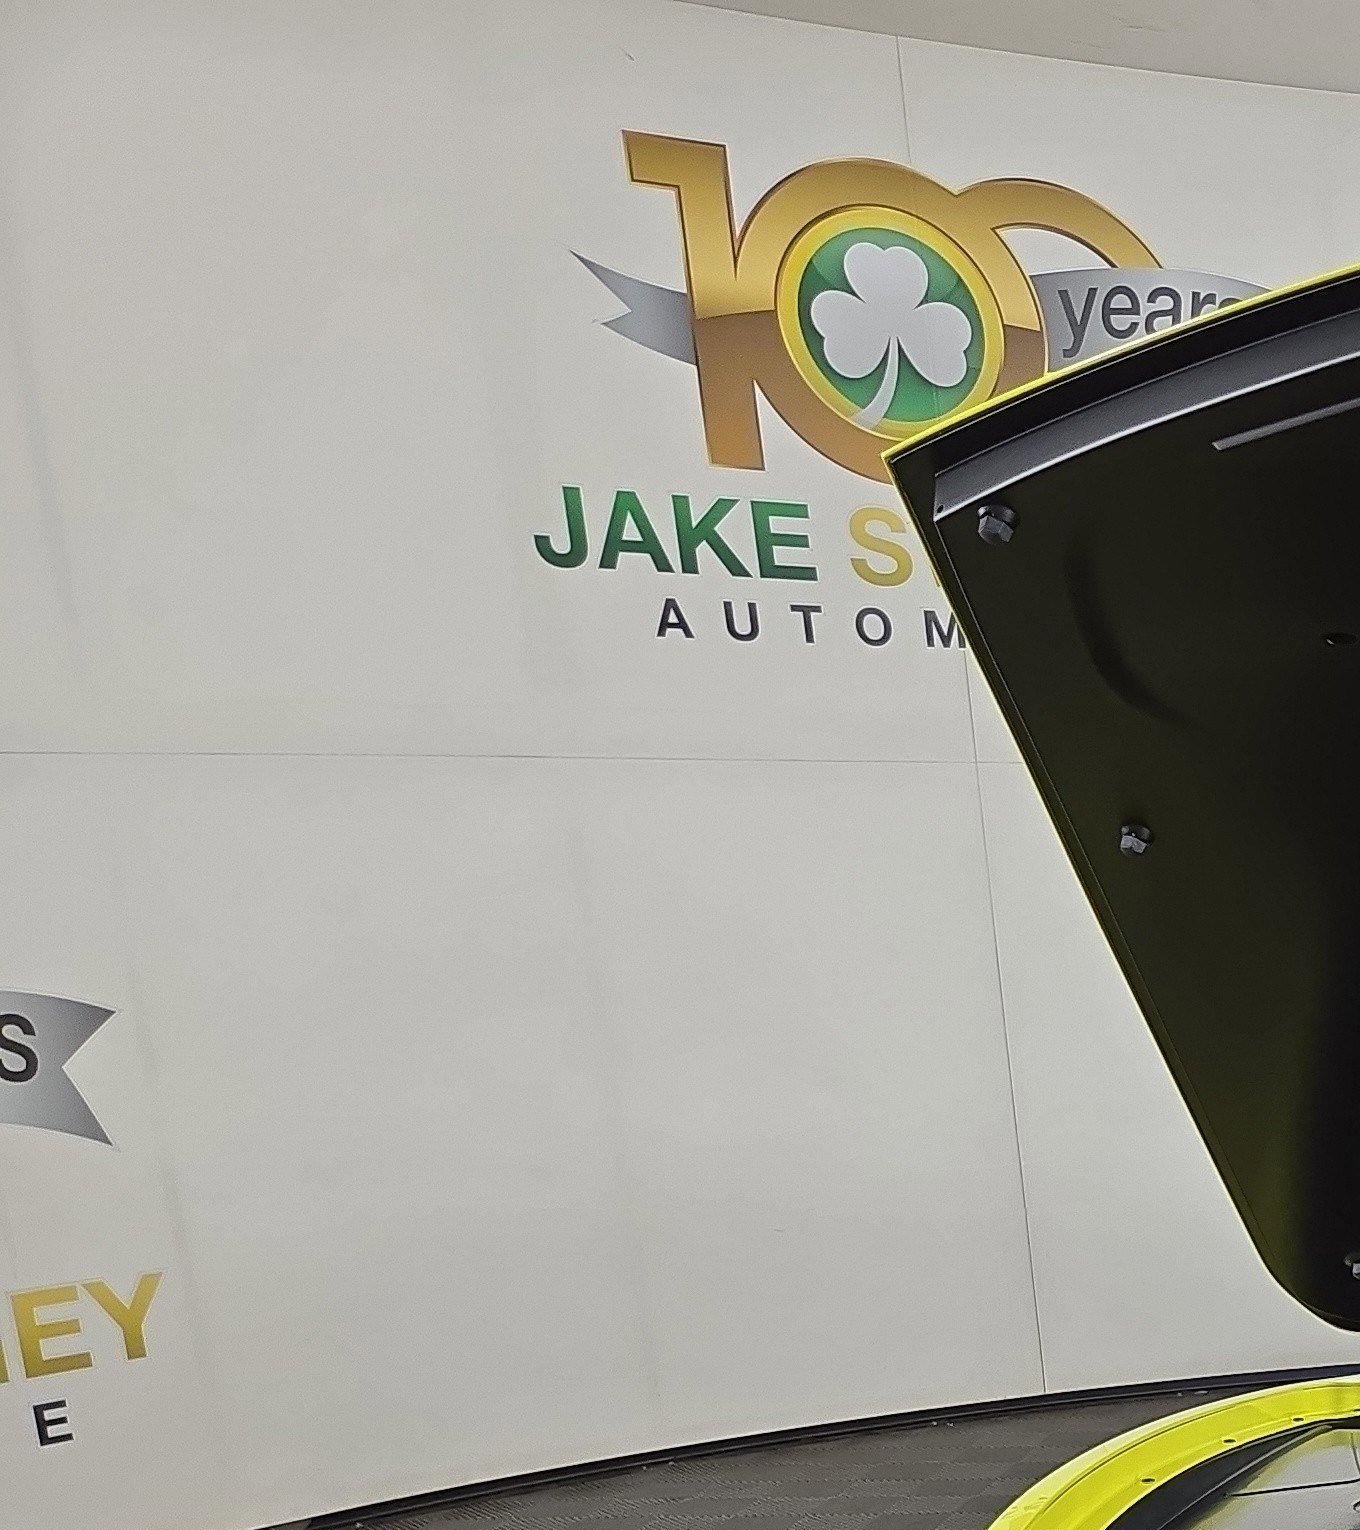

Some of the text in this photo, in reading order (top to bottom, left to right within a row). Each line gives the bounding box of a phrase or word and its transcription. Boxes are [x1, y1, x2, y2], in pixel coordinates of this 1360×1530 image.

[1057, 285, 1244, 358] year
[534, 485, 940, 587] JAKE S
[656, 597, 966, 649] AUTOM
[0, 1271, 164, 1384] EY
